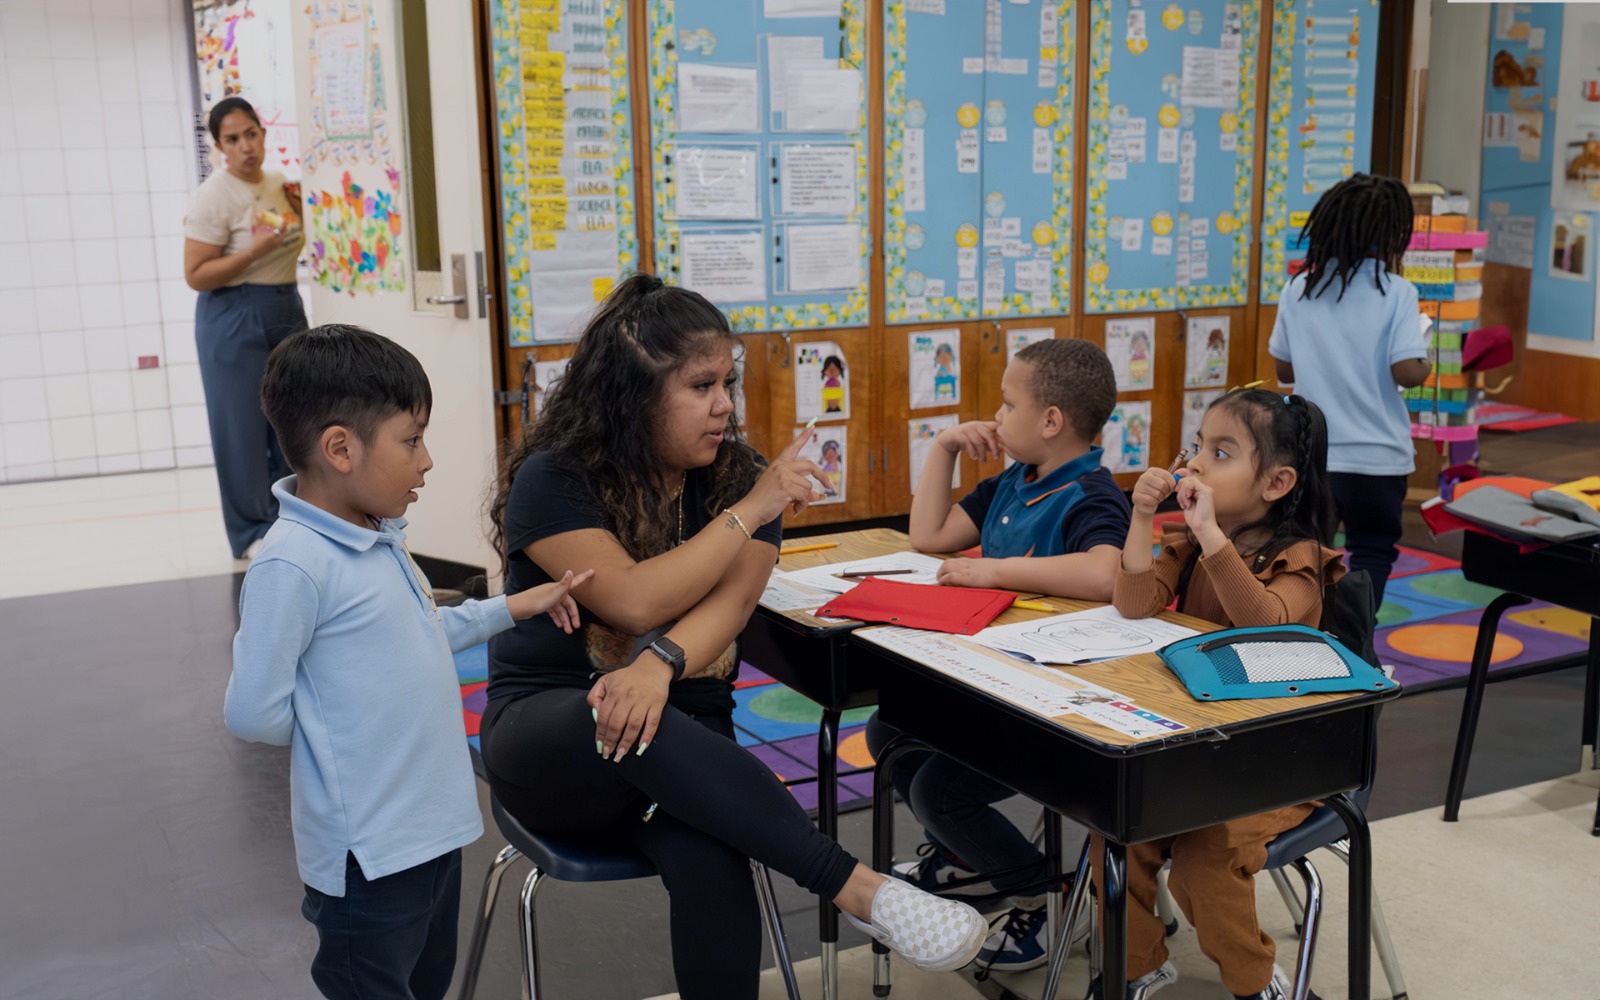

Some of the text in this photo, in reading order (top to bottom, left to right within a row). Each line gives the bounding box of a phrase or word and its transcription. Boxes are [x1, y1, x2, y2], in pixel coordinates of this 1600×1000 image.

[583, 160, 602, 175] ELA
[577, 181, 609, 193] LUNCH
[586, 215, 606, 231] ELA
